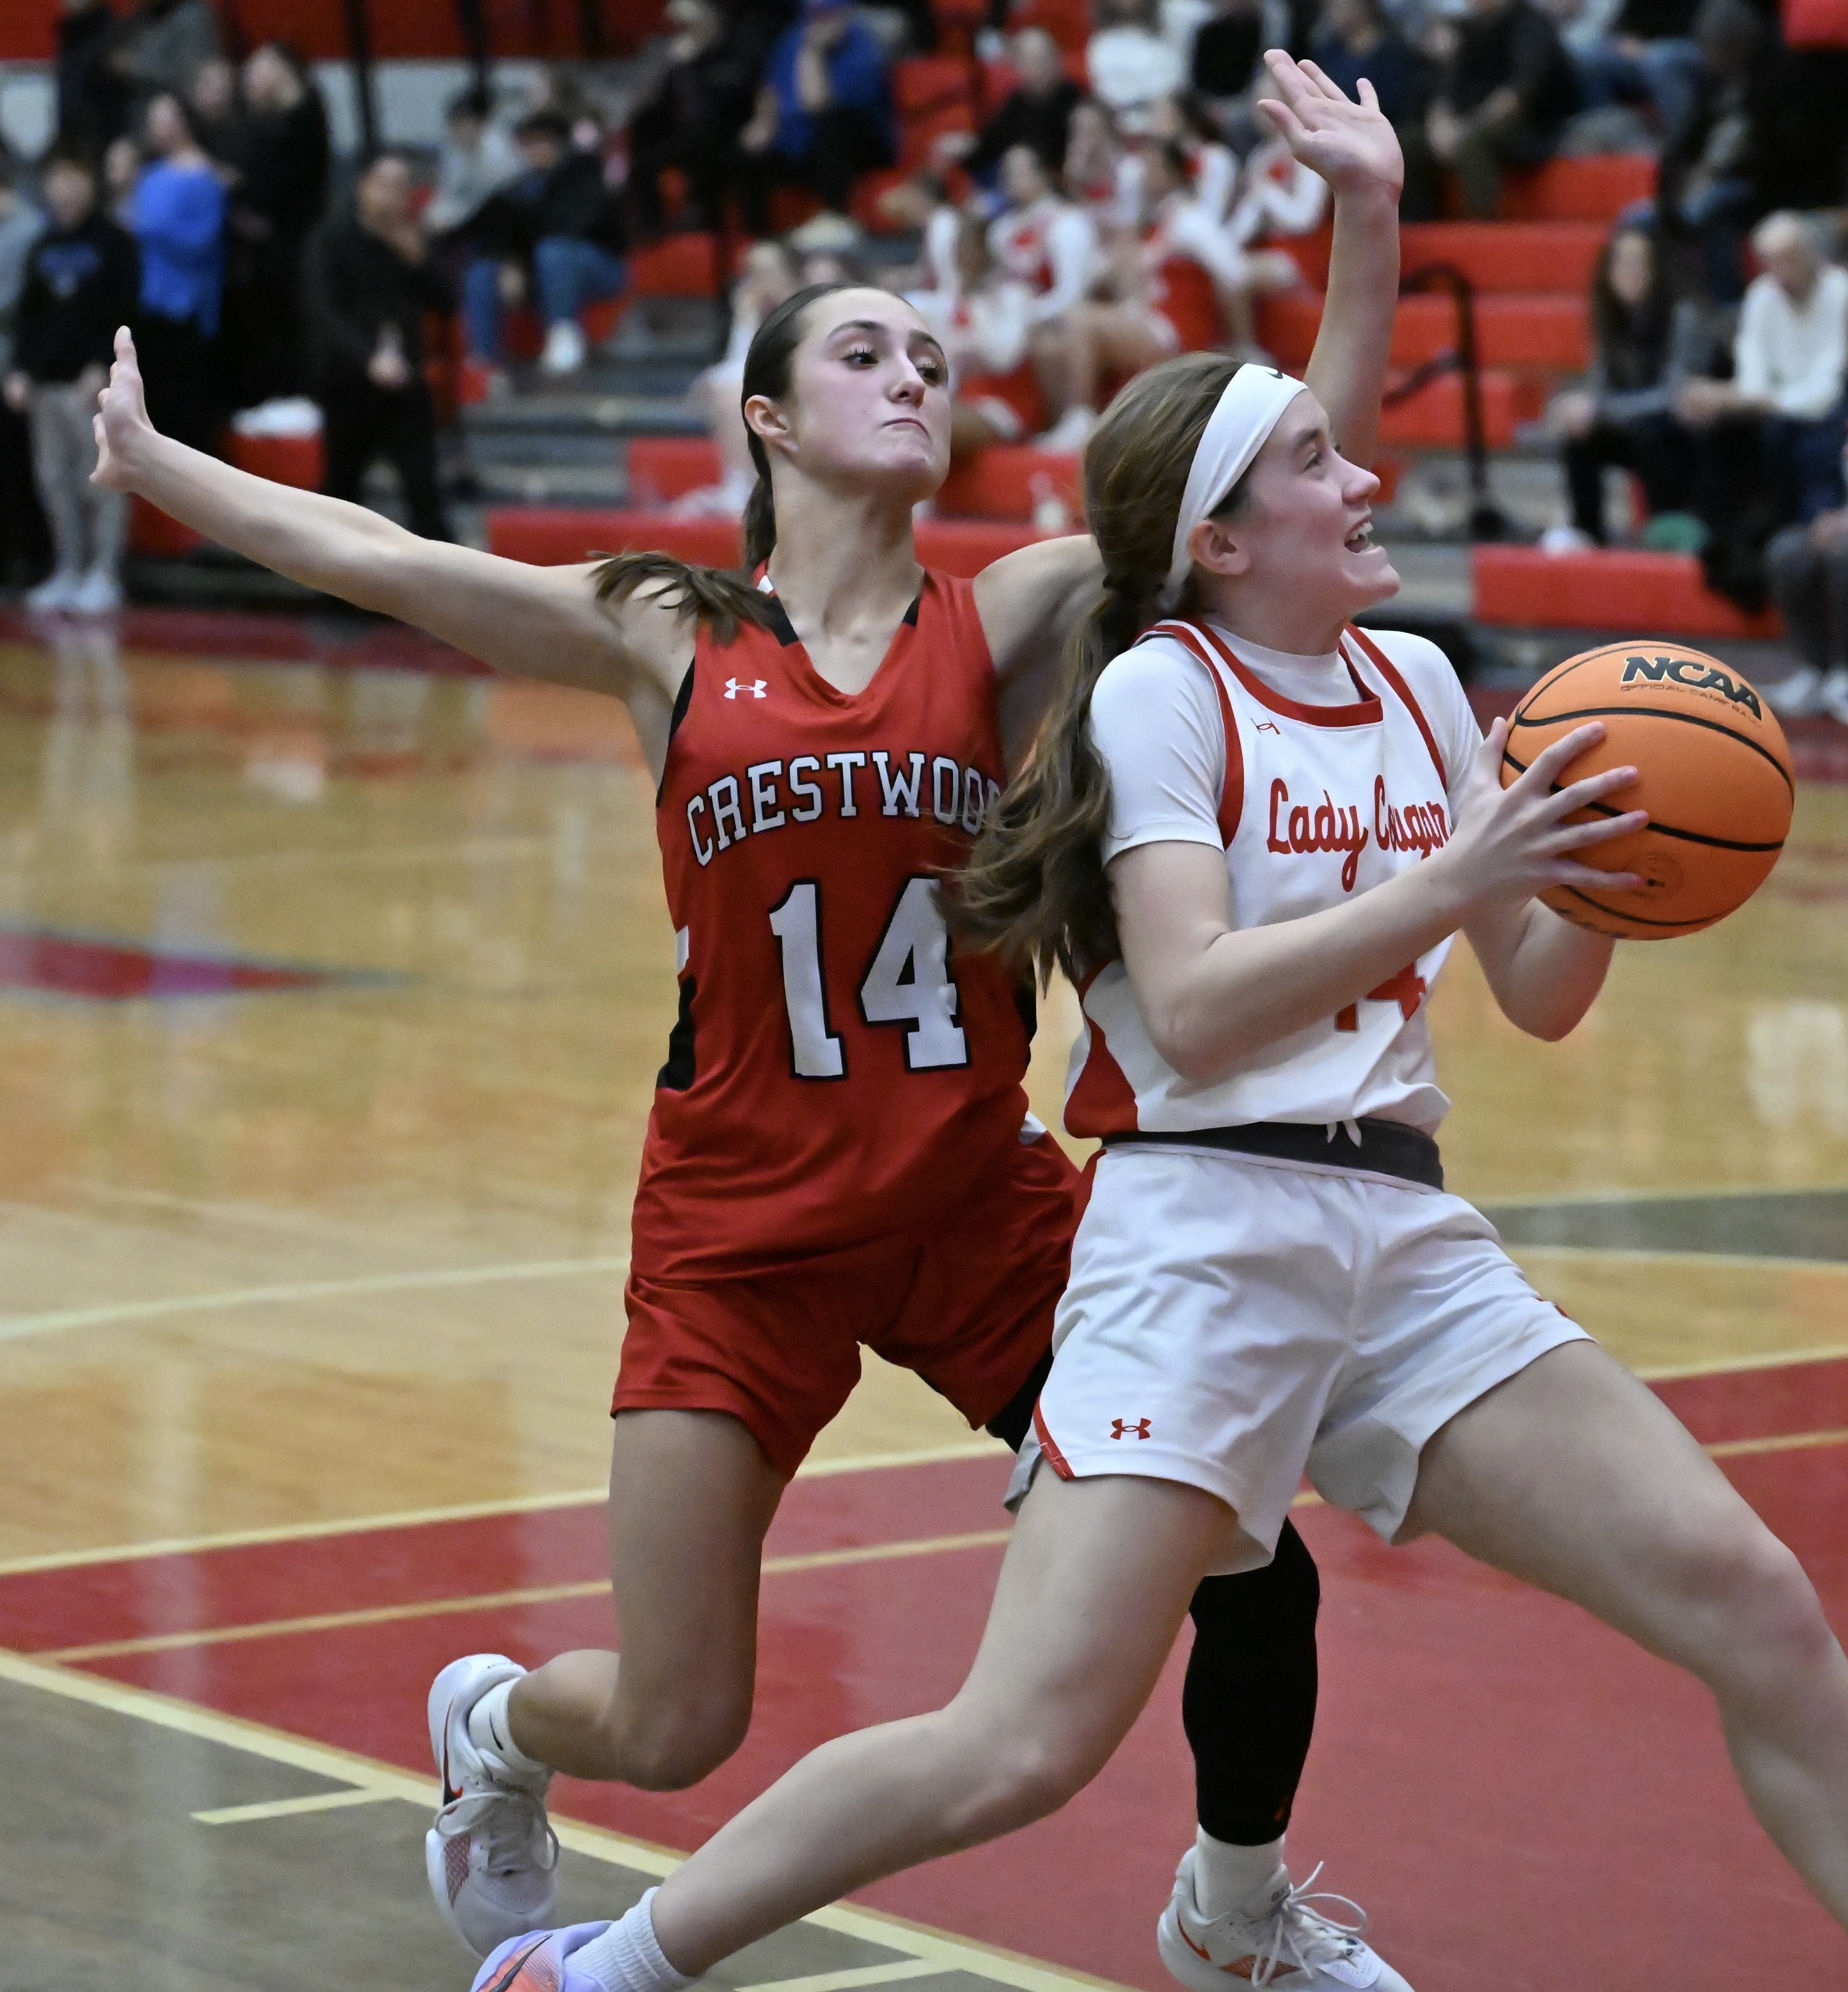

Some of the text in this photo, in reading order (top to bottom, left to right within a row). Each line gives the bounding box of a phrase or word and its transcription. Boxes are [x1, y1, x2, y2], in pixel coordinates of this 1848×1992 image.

[1621, 656, 1762, 721] NCAA
[1266, 777, 1369, 892] Lady
[767, 876, 970, 1079] 14
